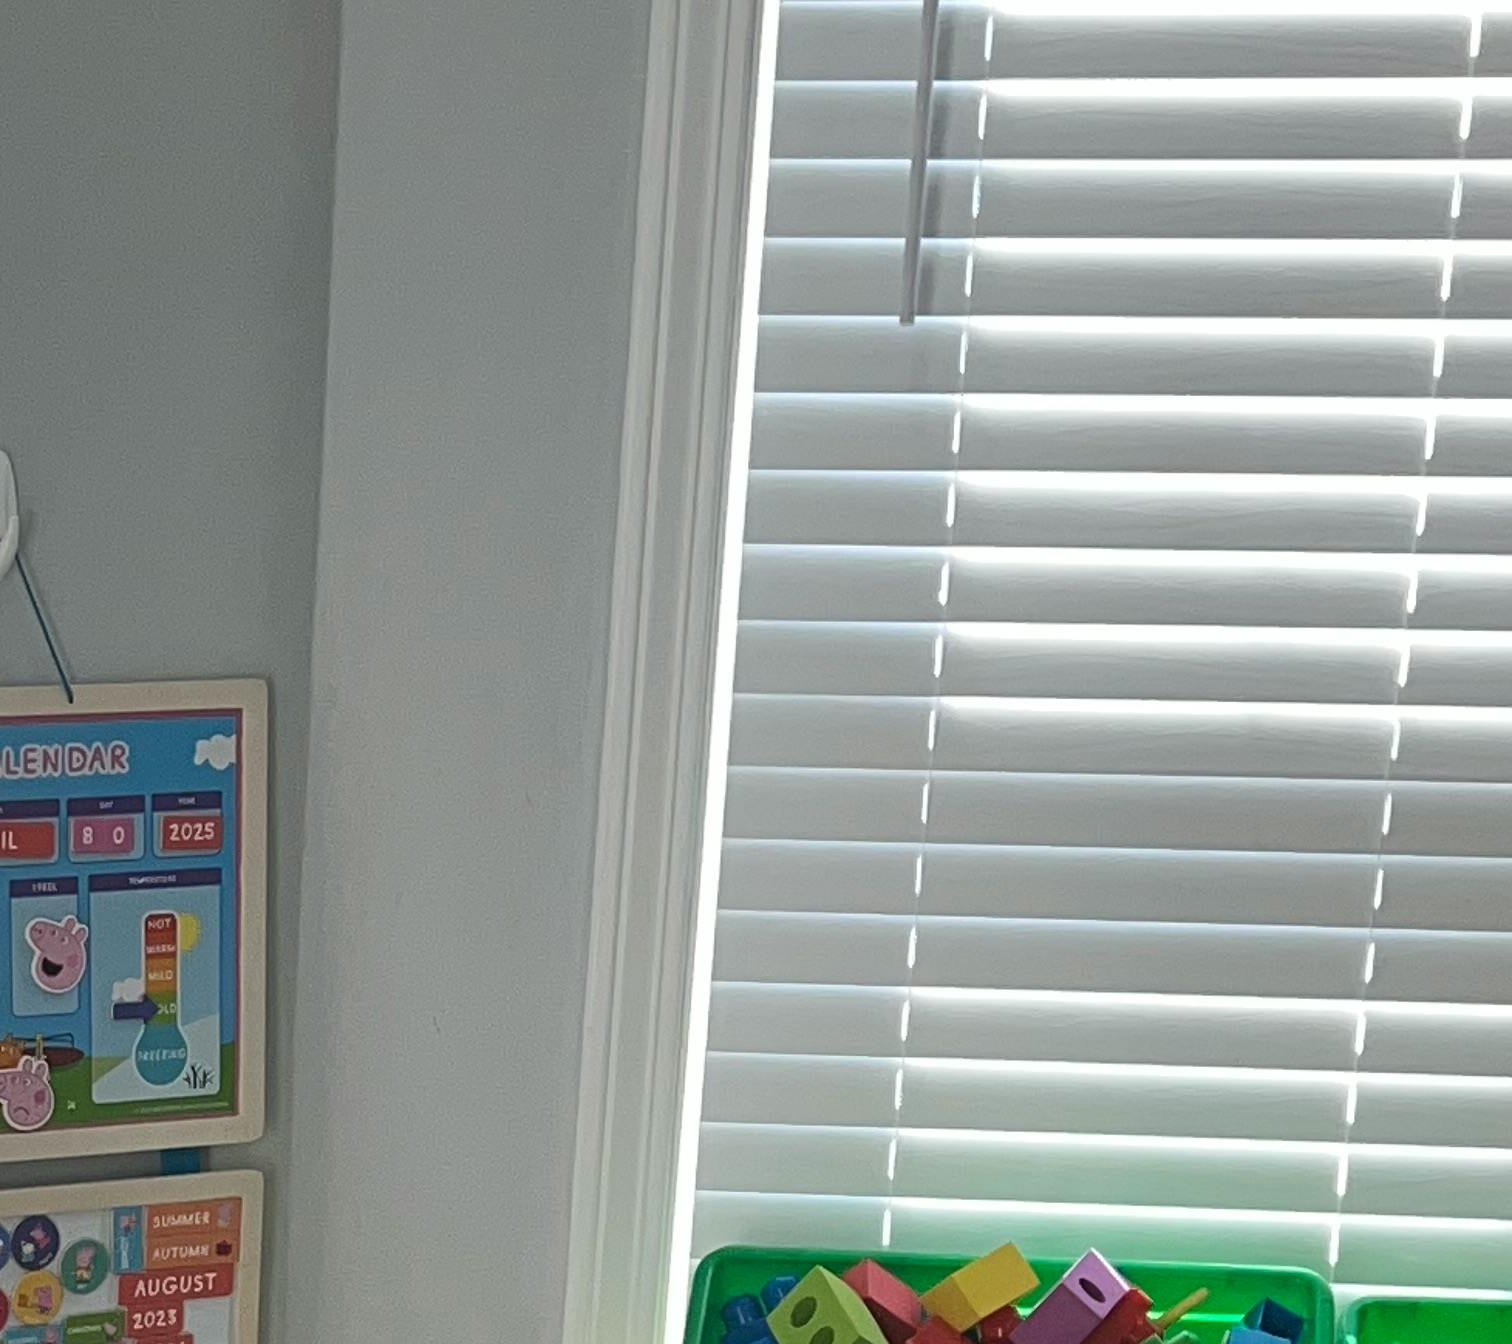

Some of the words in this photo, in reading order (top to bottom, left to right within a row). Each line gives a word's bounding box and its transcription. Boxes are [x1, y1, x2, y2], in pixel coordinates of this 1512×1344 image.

[82, 826, 94, 845] 8
[112, 826, 126, 845] 0
[168, 822, 216, 843] 2025
[38, 882, 58, 893] FEEL
[147, 970, 174, 981] MILD
[152, 1212, 210, 1229] SUMMER
[152, 1244, 210, 1261] AUTUMN
[134, 1272, 217, 1298] AUGUST
